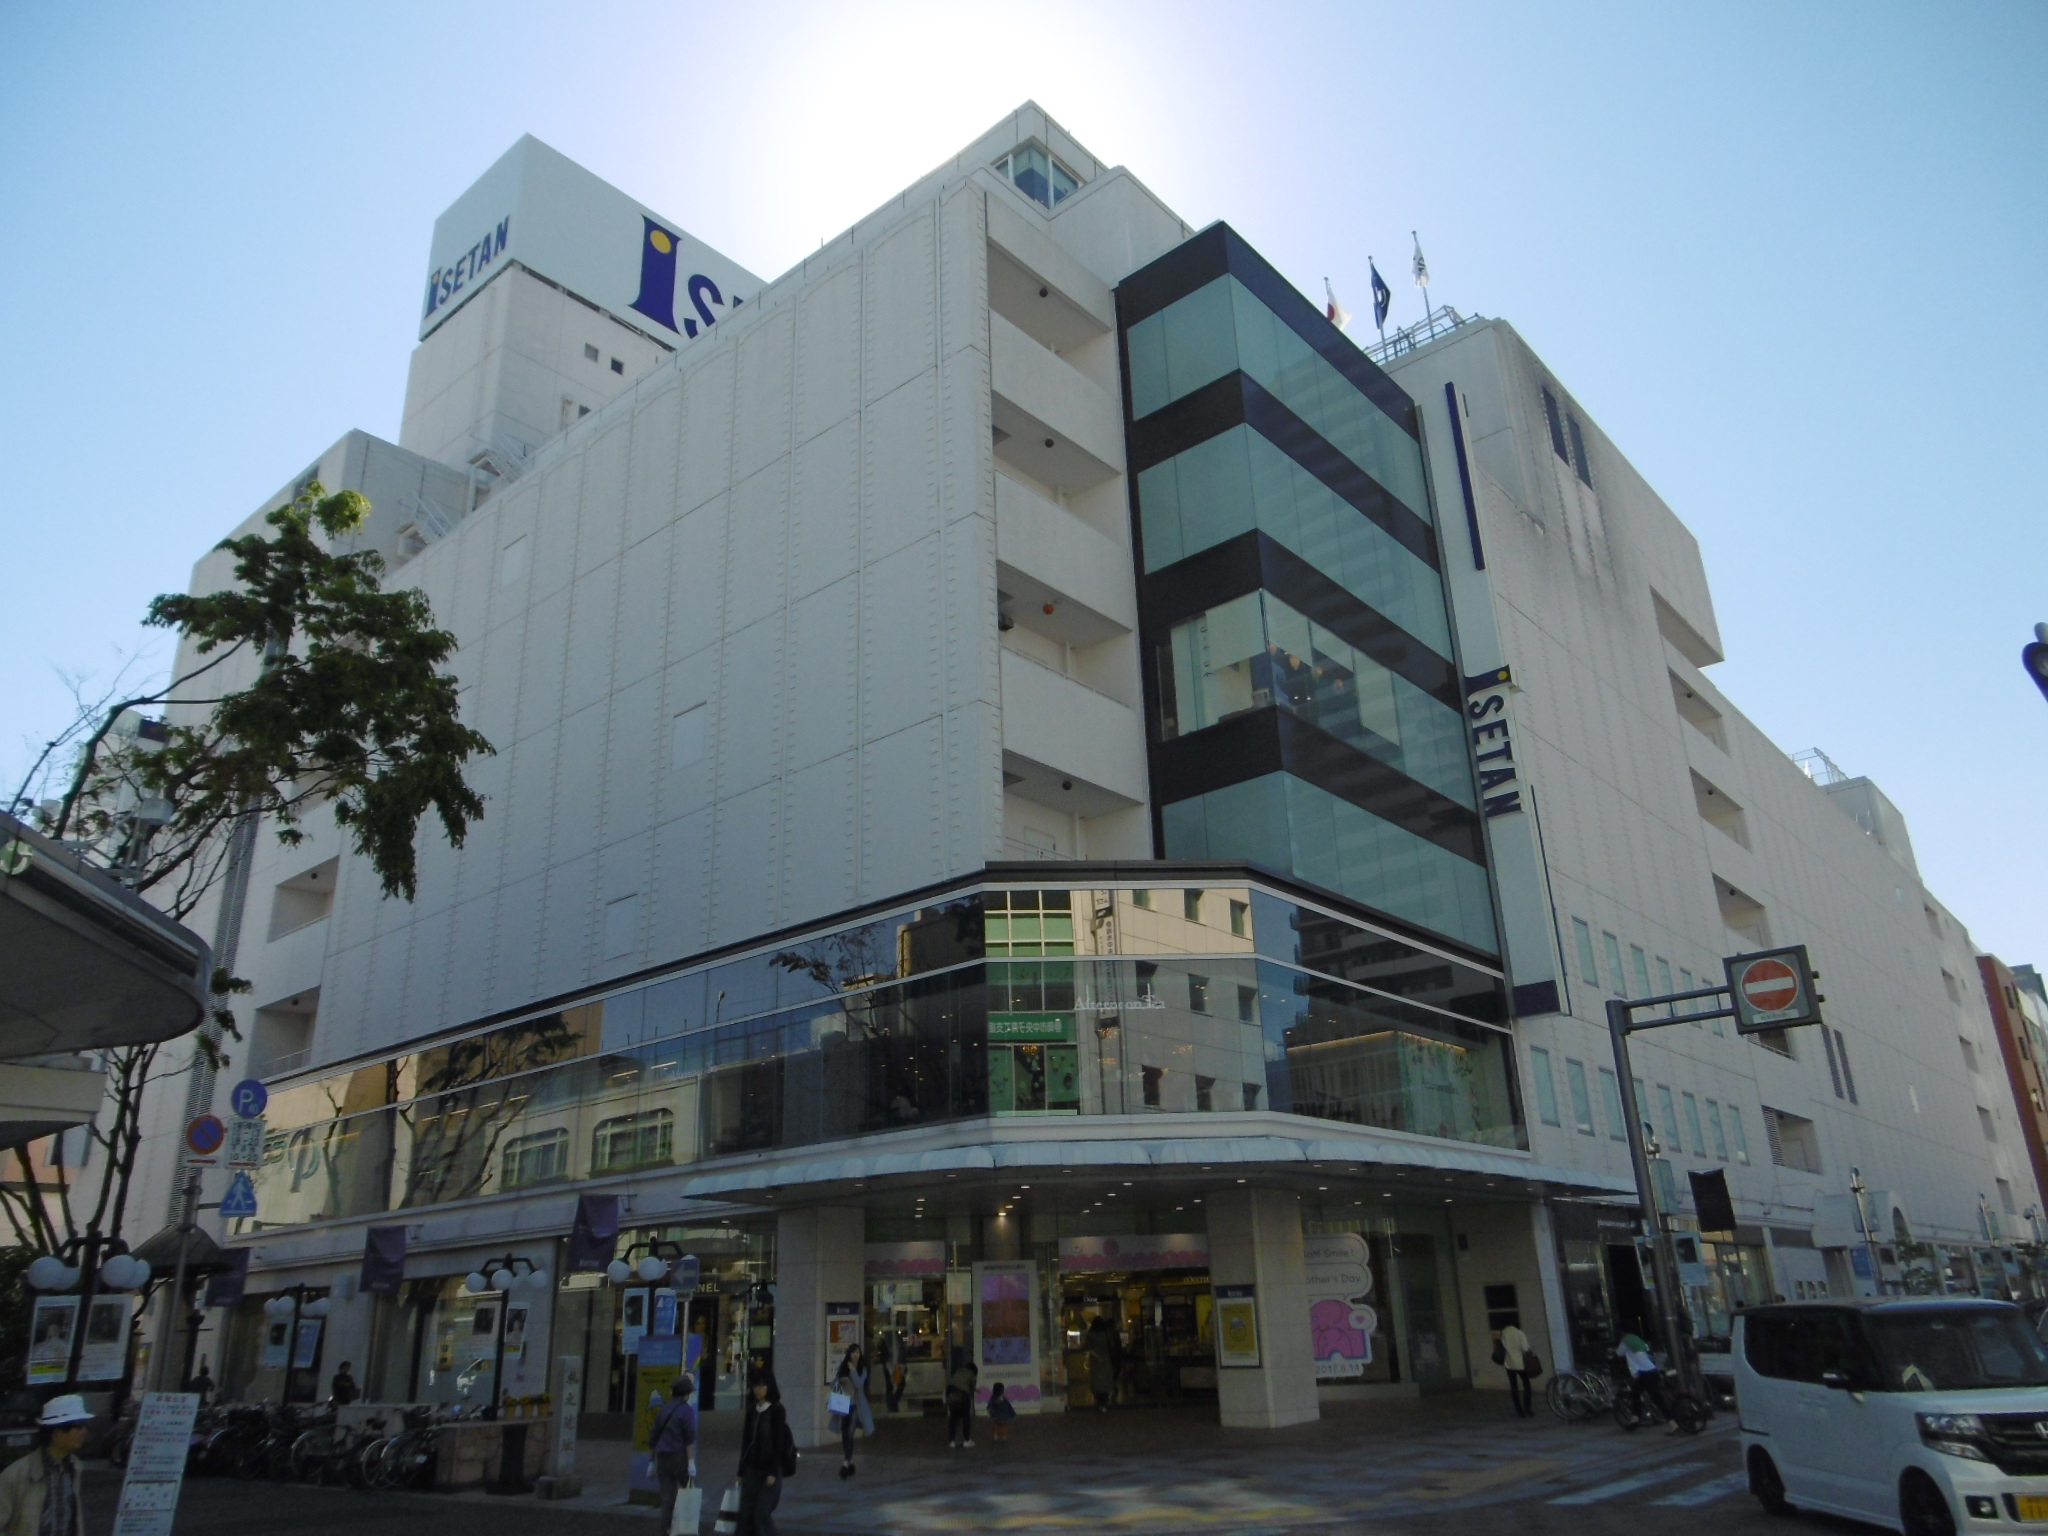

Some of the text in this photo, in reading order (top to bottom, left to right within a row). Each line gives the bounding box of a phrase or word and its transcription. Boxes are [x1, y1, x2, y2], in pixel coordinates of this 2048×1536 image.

[424, 213, 511, 320] ISETAN
[626, 212, 744, 340] IS
[1464, 665, 1522, 817] ISETAN
[1073, 982, 1166, 1010] Afternoon Tea
[239, 1089, 254, 1113] P
[1306, 1273, 1361, 1284] other's Day
